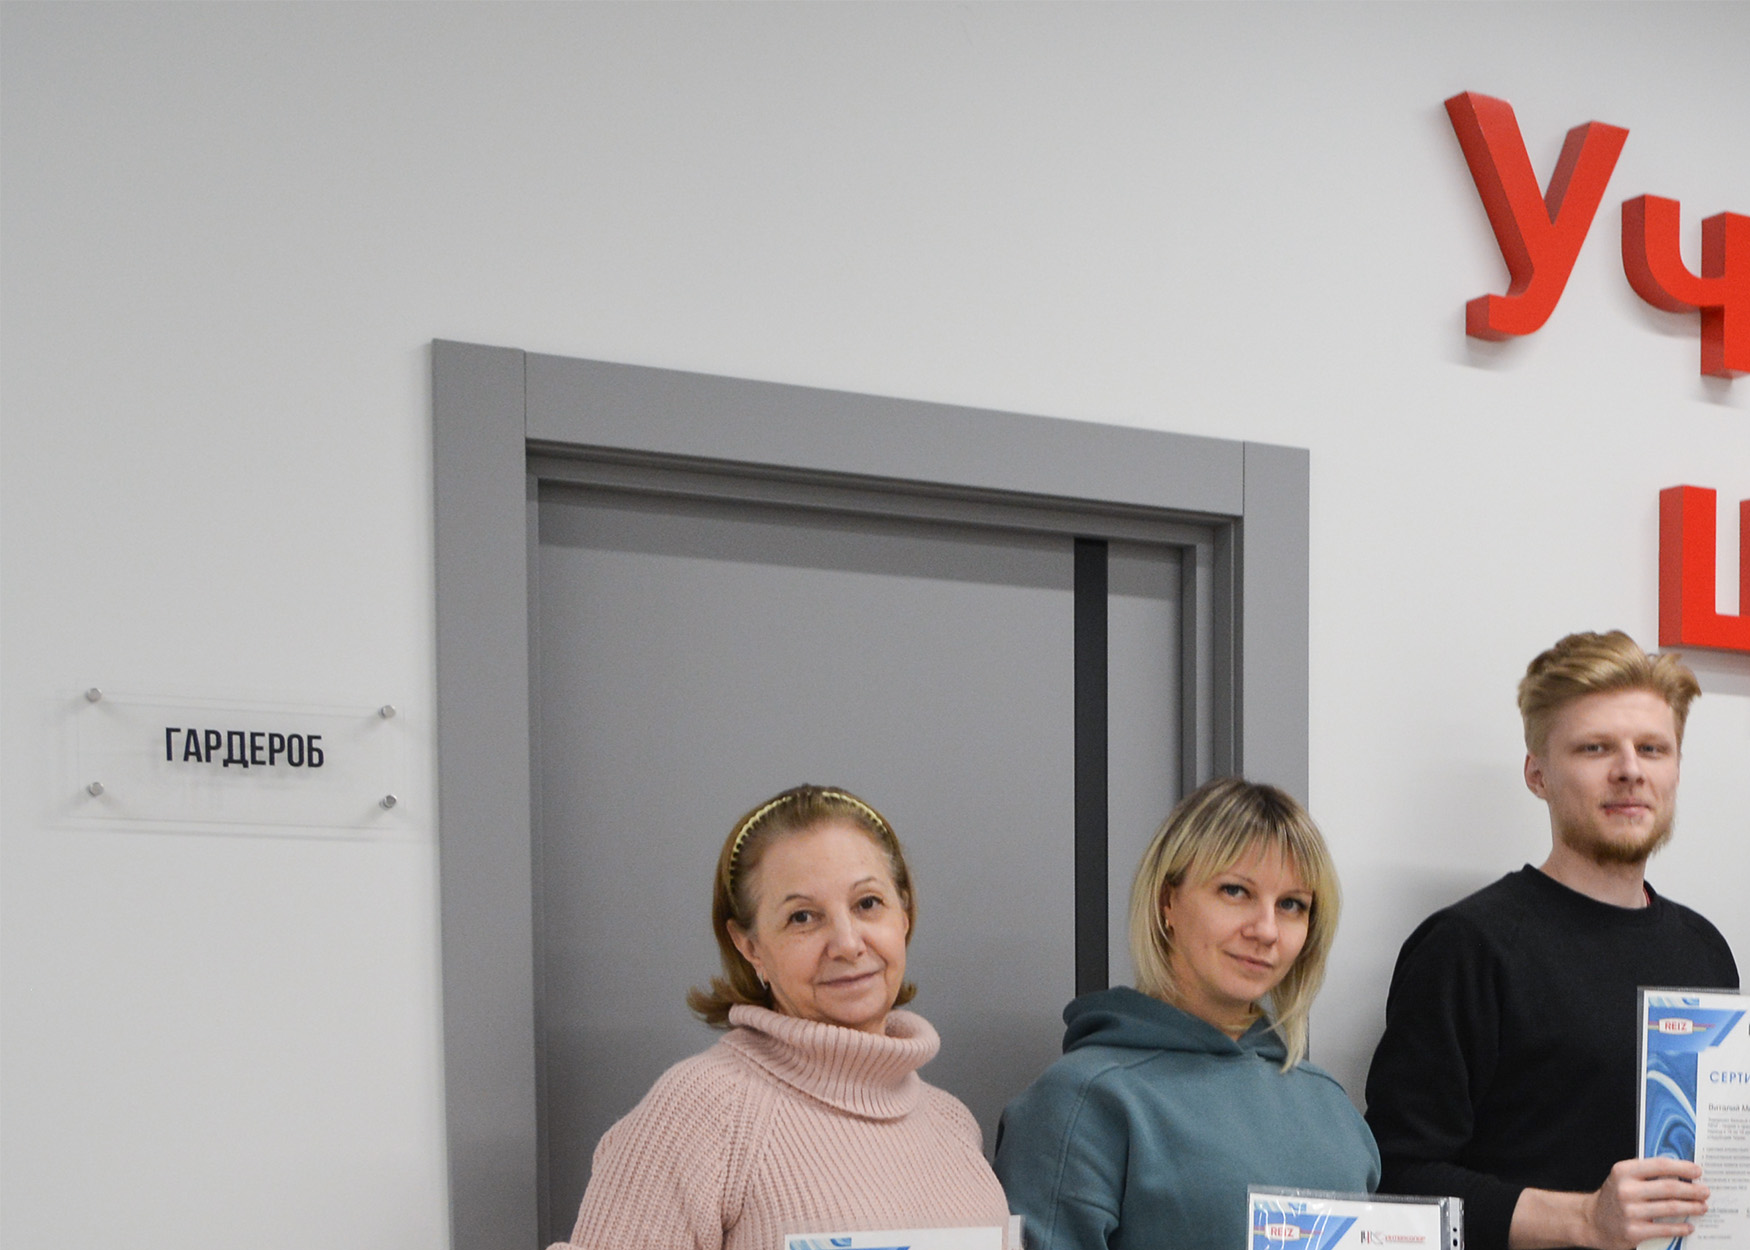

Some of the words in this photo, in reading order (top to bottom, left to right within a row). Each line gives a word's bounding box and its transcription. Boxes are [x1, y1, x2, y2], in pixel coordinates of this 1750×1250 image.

[165, 727, 324, 768] ГАРДЕРОБ
[1664, 1020, 1688, 1032] REIZ
[1270, 1226, 1294, 1238] REIZ
